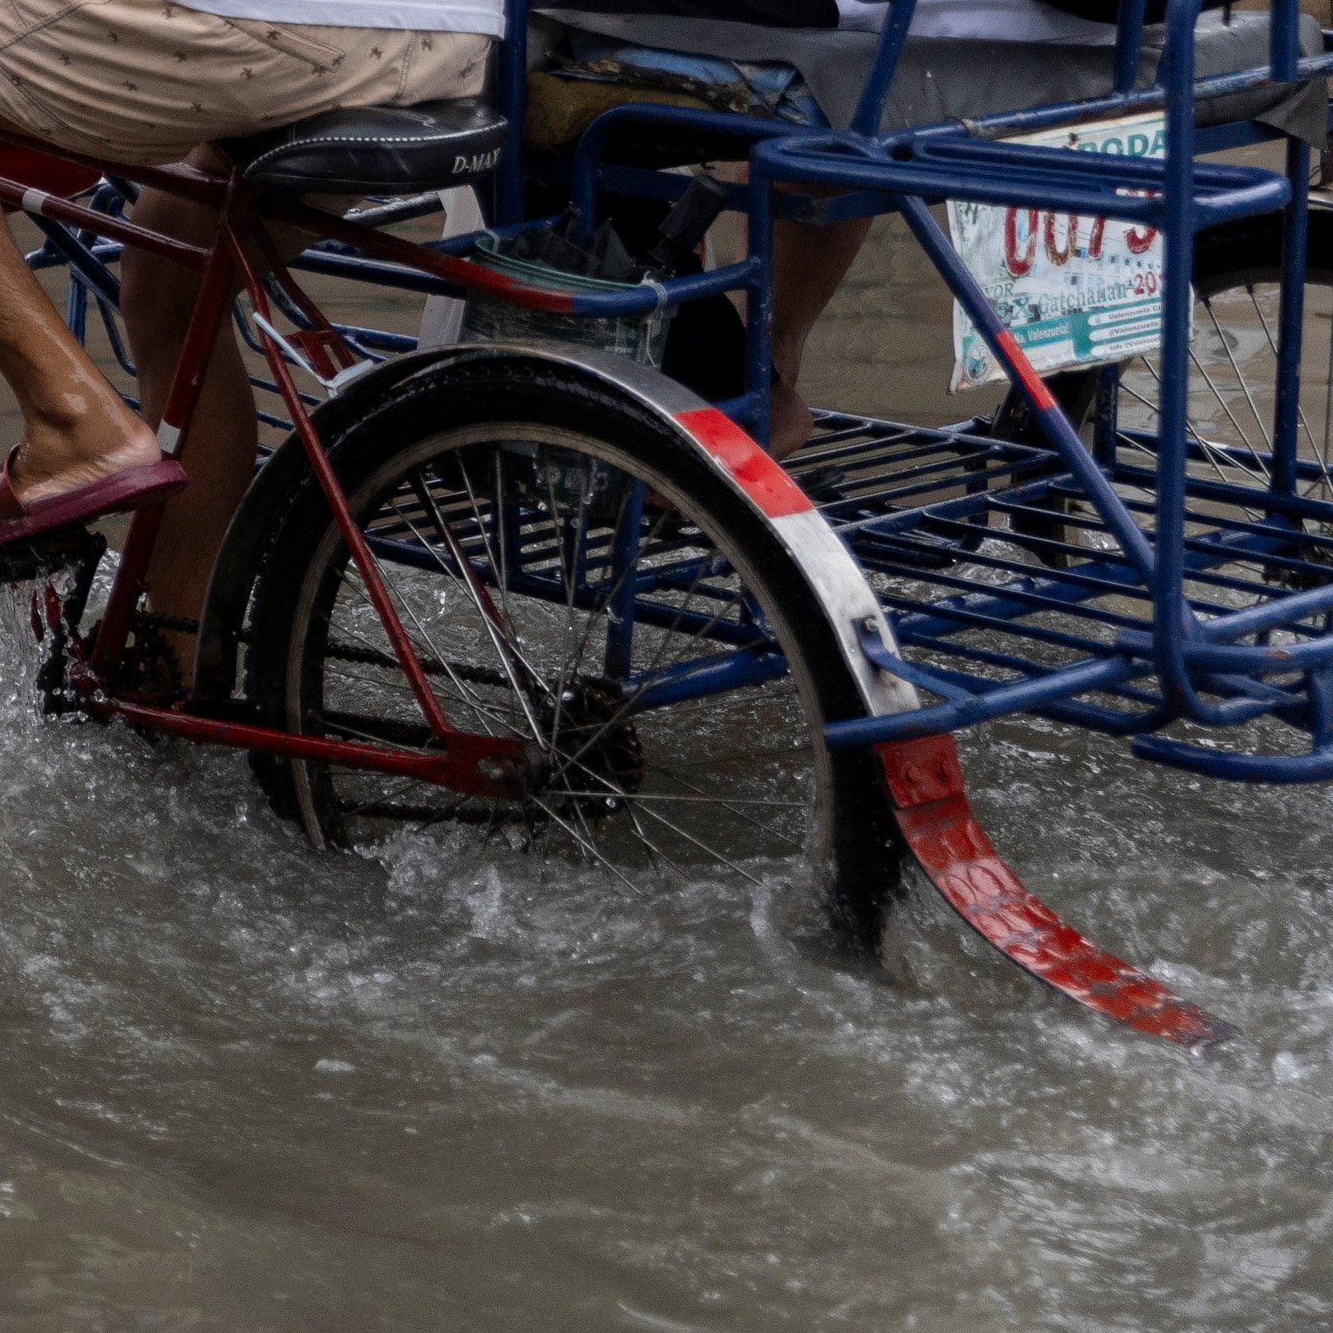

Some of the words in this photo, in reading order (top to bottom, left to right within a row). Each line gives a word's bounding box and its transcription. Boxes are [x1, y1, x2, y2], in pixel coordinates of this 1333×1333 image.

[983, 283, 1015, 299] YOR
[1037, 282, 1128, 317] Gatchalian
[1027, 322, 1070, 342] Valenzuela!
